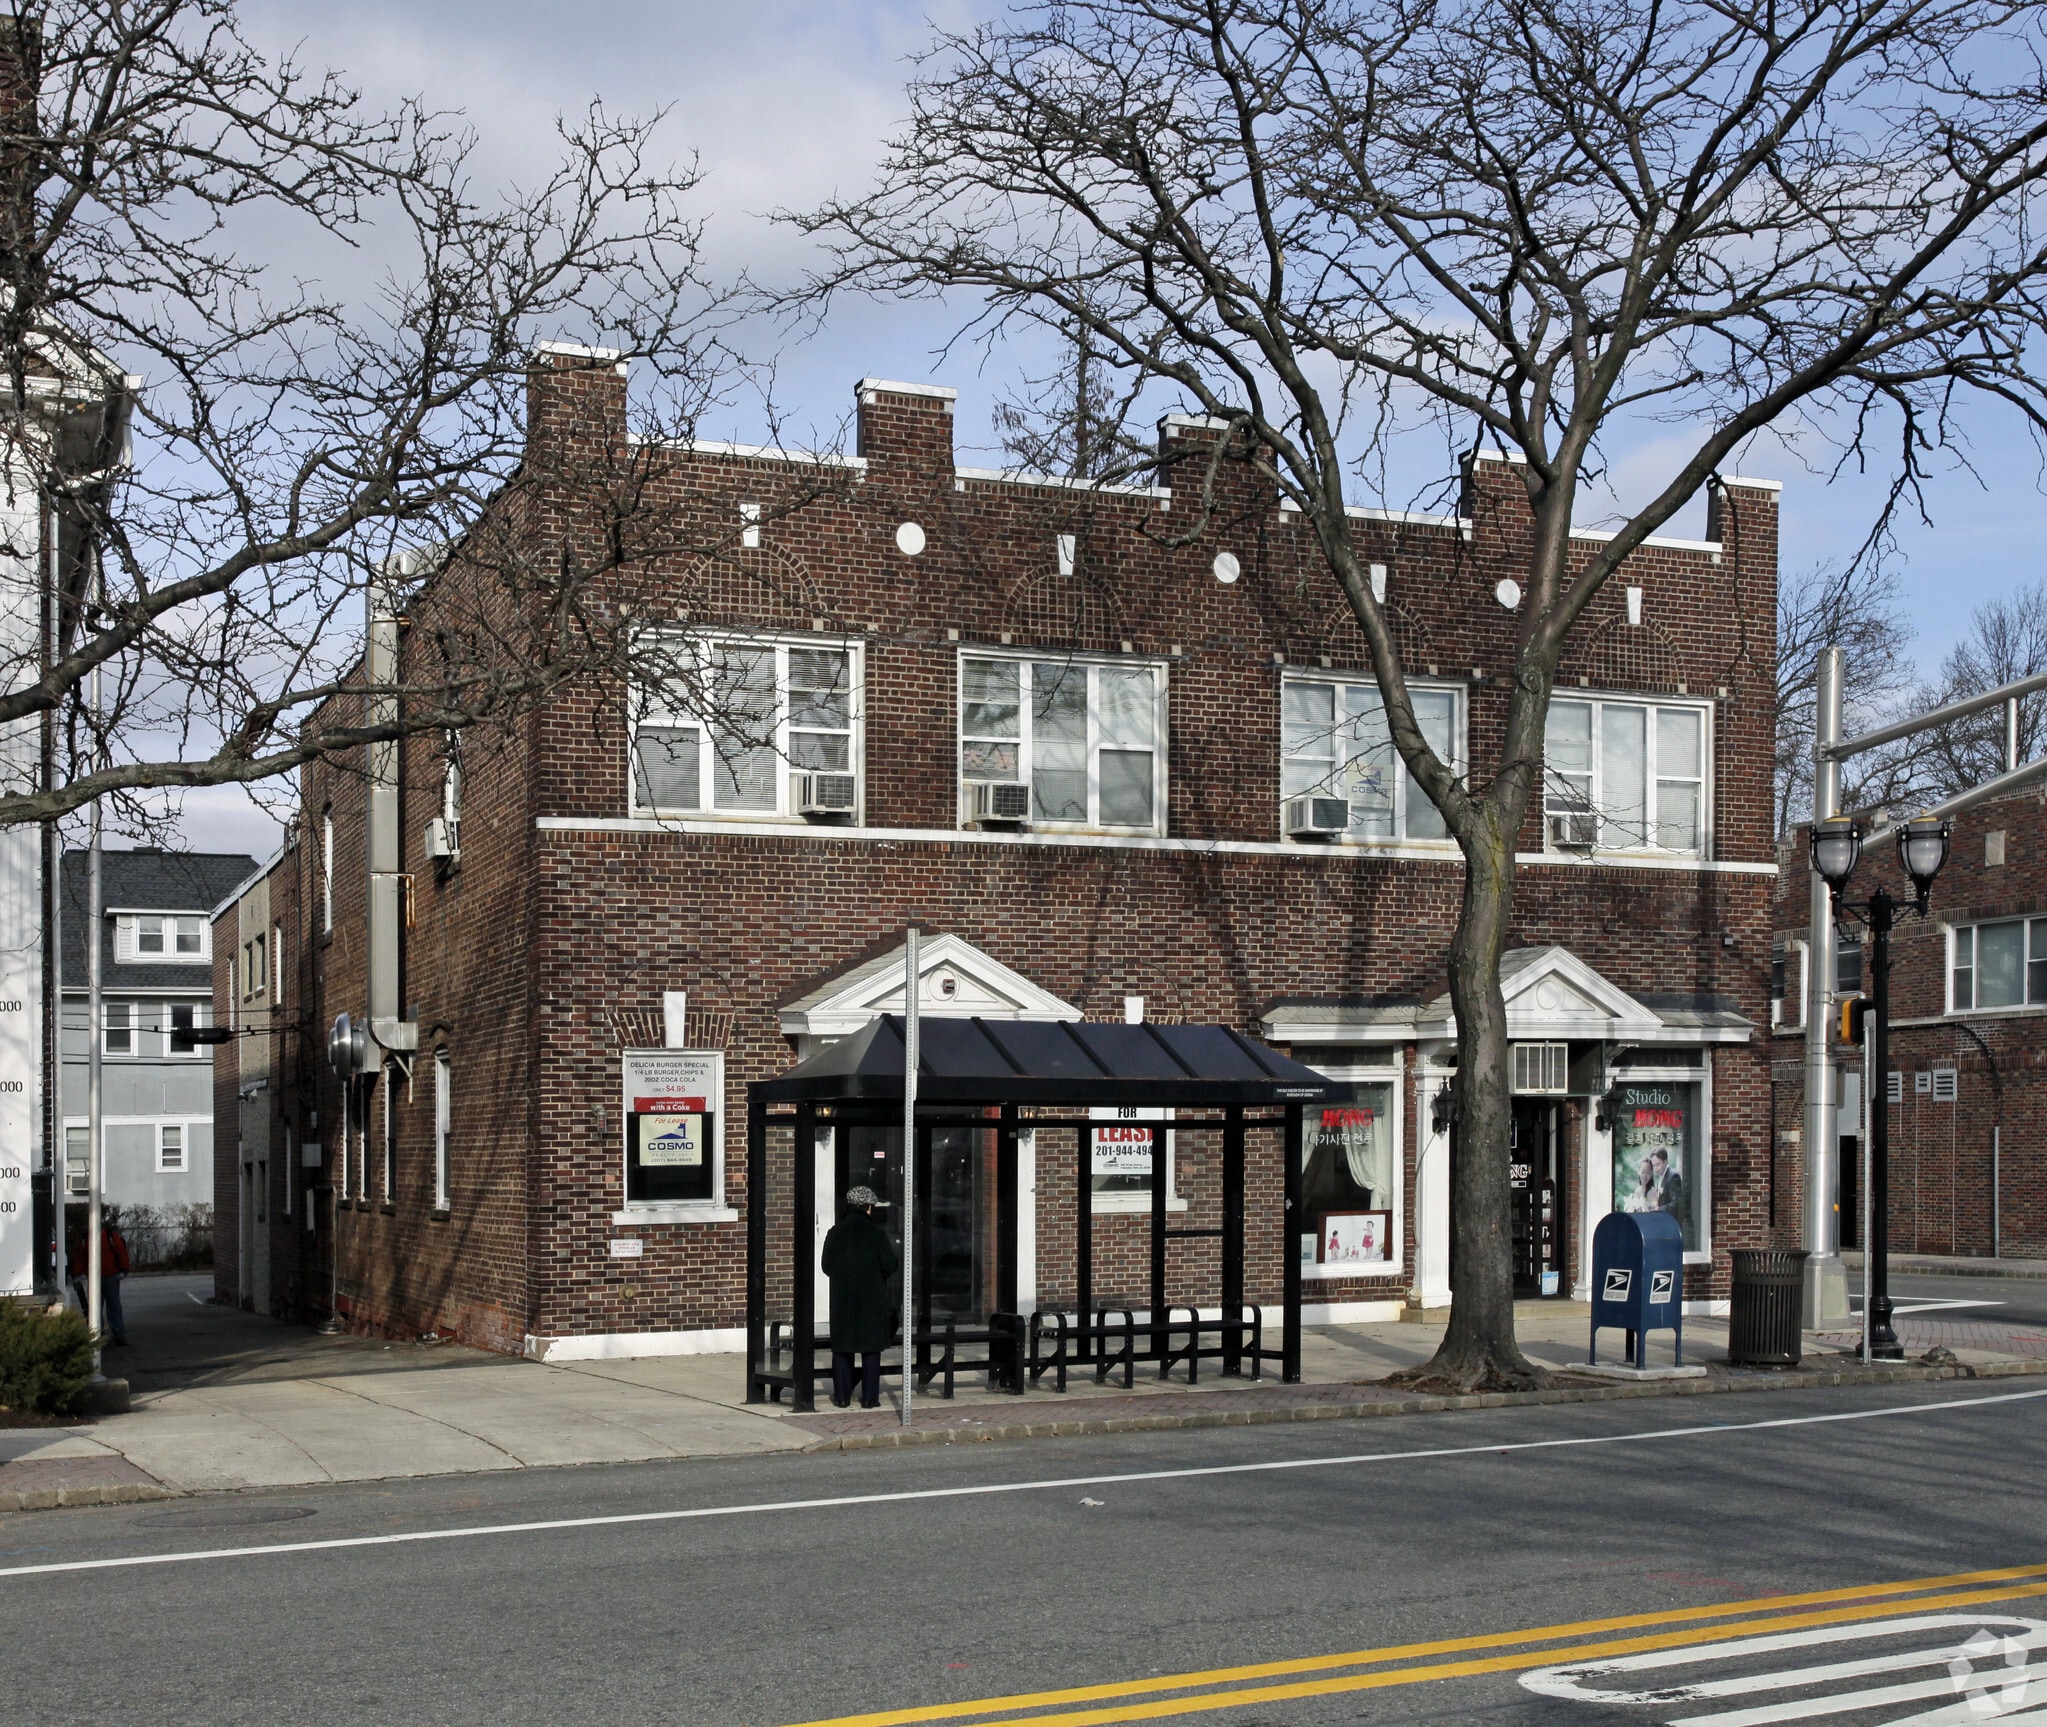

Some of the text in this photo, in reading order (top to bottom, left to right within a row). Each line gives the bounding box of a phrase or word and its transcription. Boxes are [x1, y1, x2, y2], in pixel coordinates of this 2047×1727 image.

[665, 1085, 686, 1093] $4.95
[1625, 1088, 1671, 1105] Studio
[1118, 1107, 1137, 1118] FOR
[1321, 1108, 1374, 1127] HONG
[1632, 1109, 1683, 1129] HONG
[648, 1142, 694, 1151] COSMO
[1095, 1145, 1153, 1156] 201-944-494
